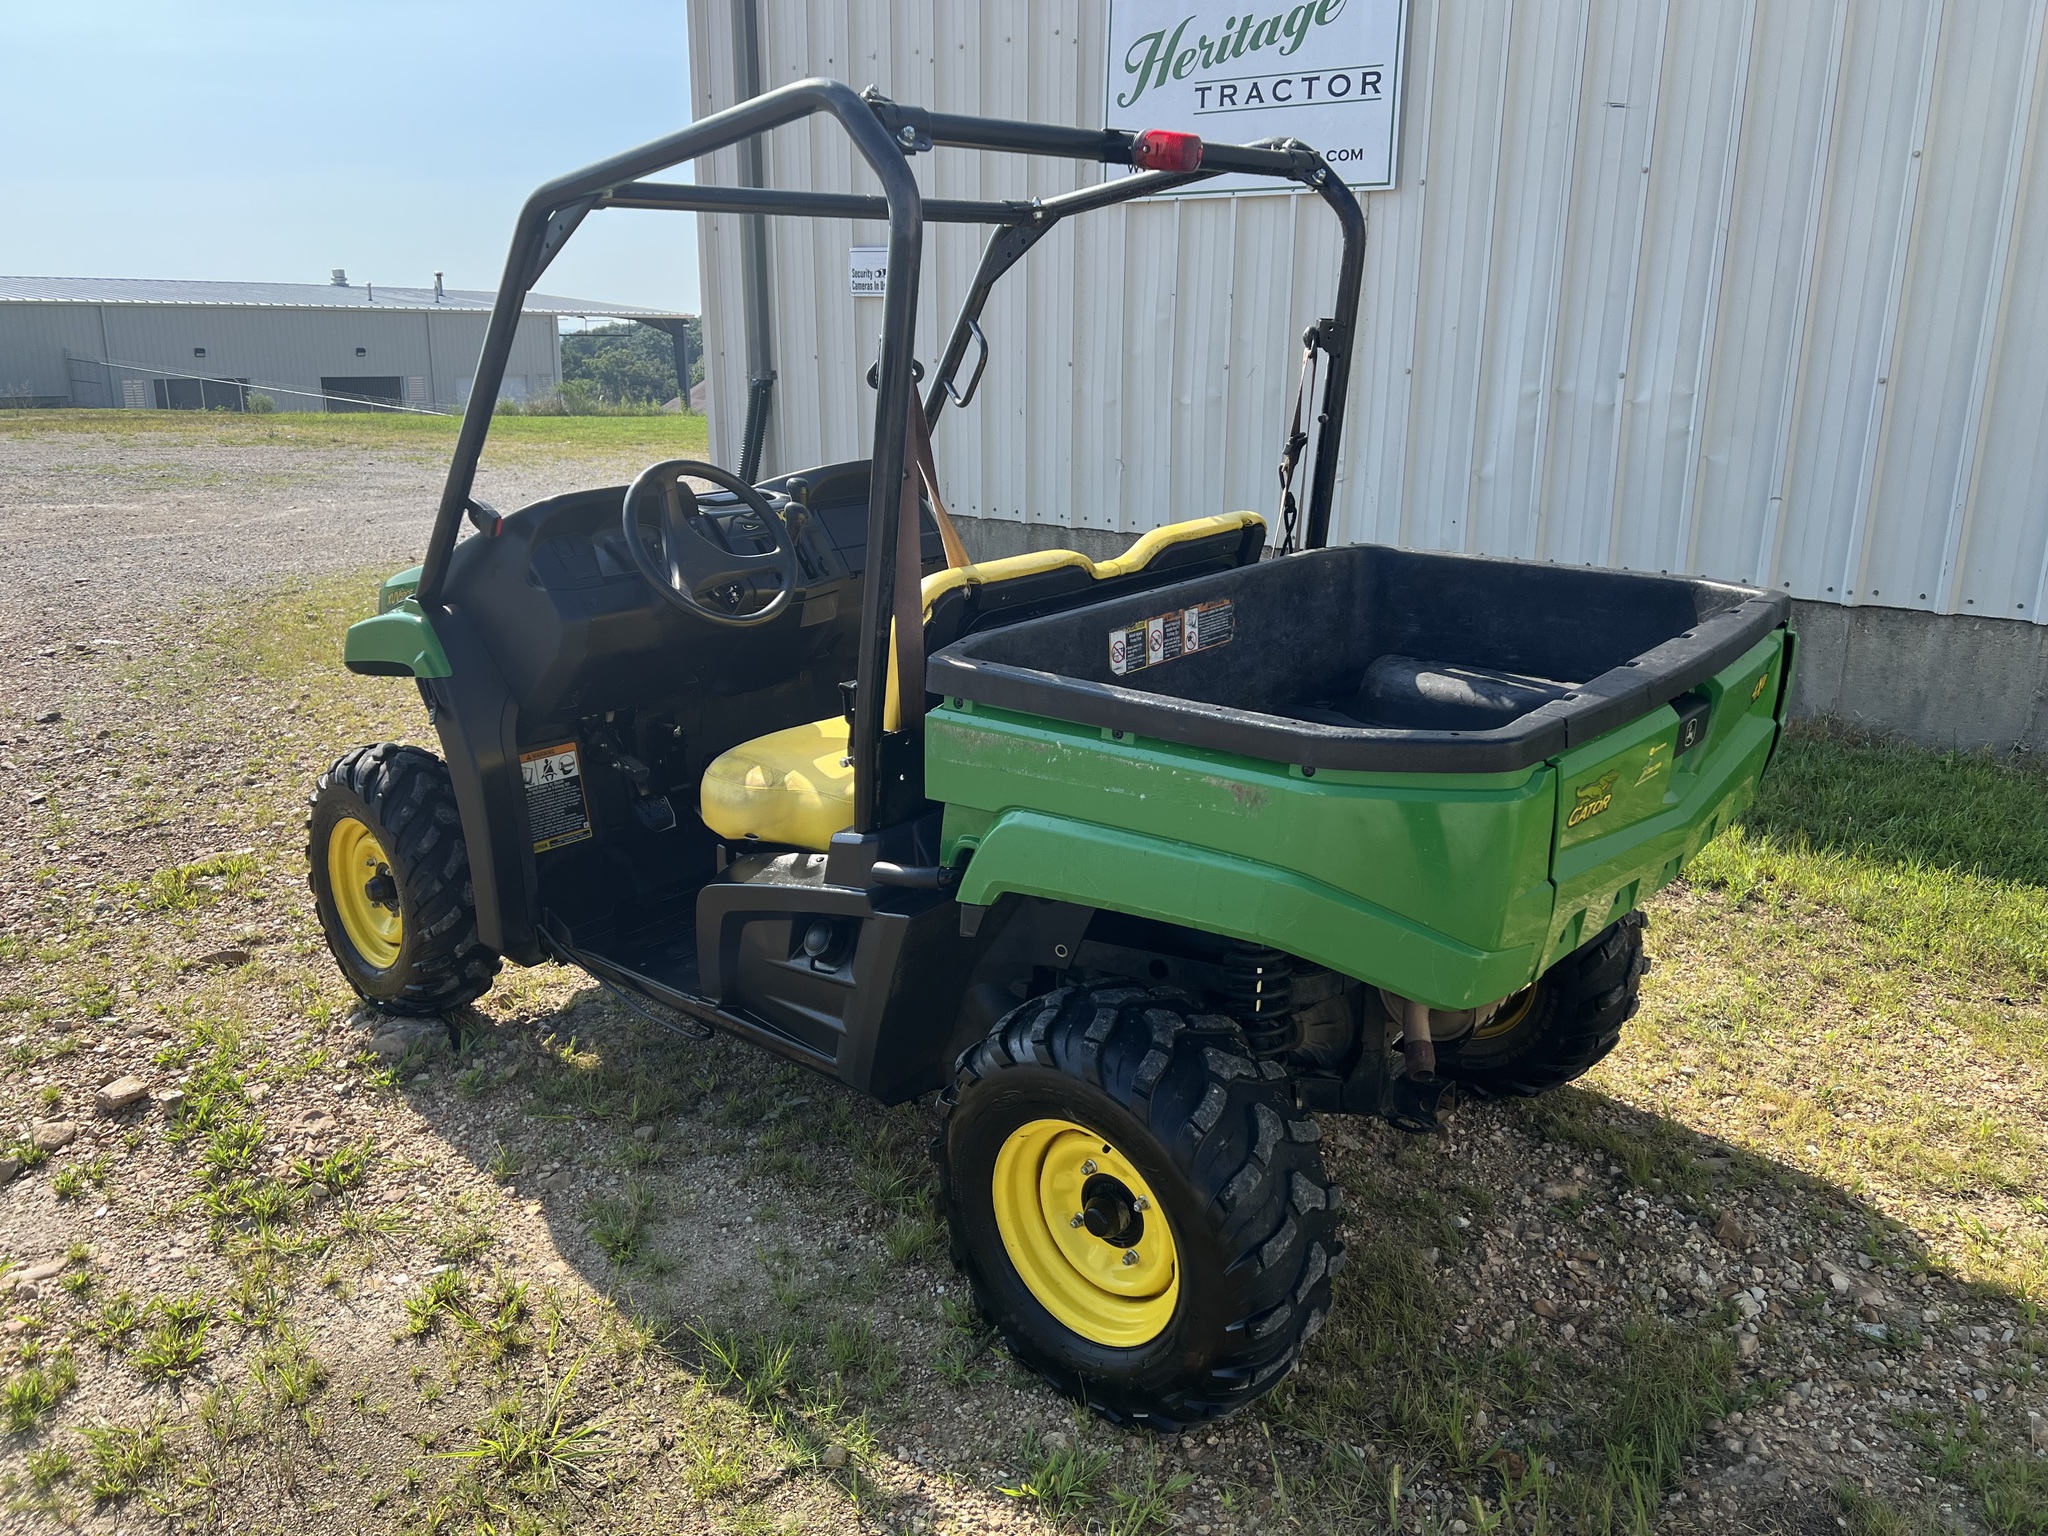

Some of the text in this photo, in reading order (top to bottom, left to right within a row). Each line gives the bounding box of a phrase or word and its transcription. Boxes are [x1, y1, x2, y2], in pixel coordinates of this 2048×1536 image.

[1117, 0, 1347, 108] Heritage
[1194, 71, 1382, 109] TRACTOR
[852, 268, 873, 280] Security
[852, 280, 873, 290] Cameras
[532, 749, 555, 759] WARNING
[1568, 794, 1612, 827] GATOR
